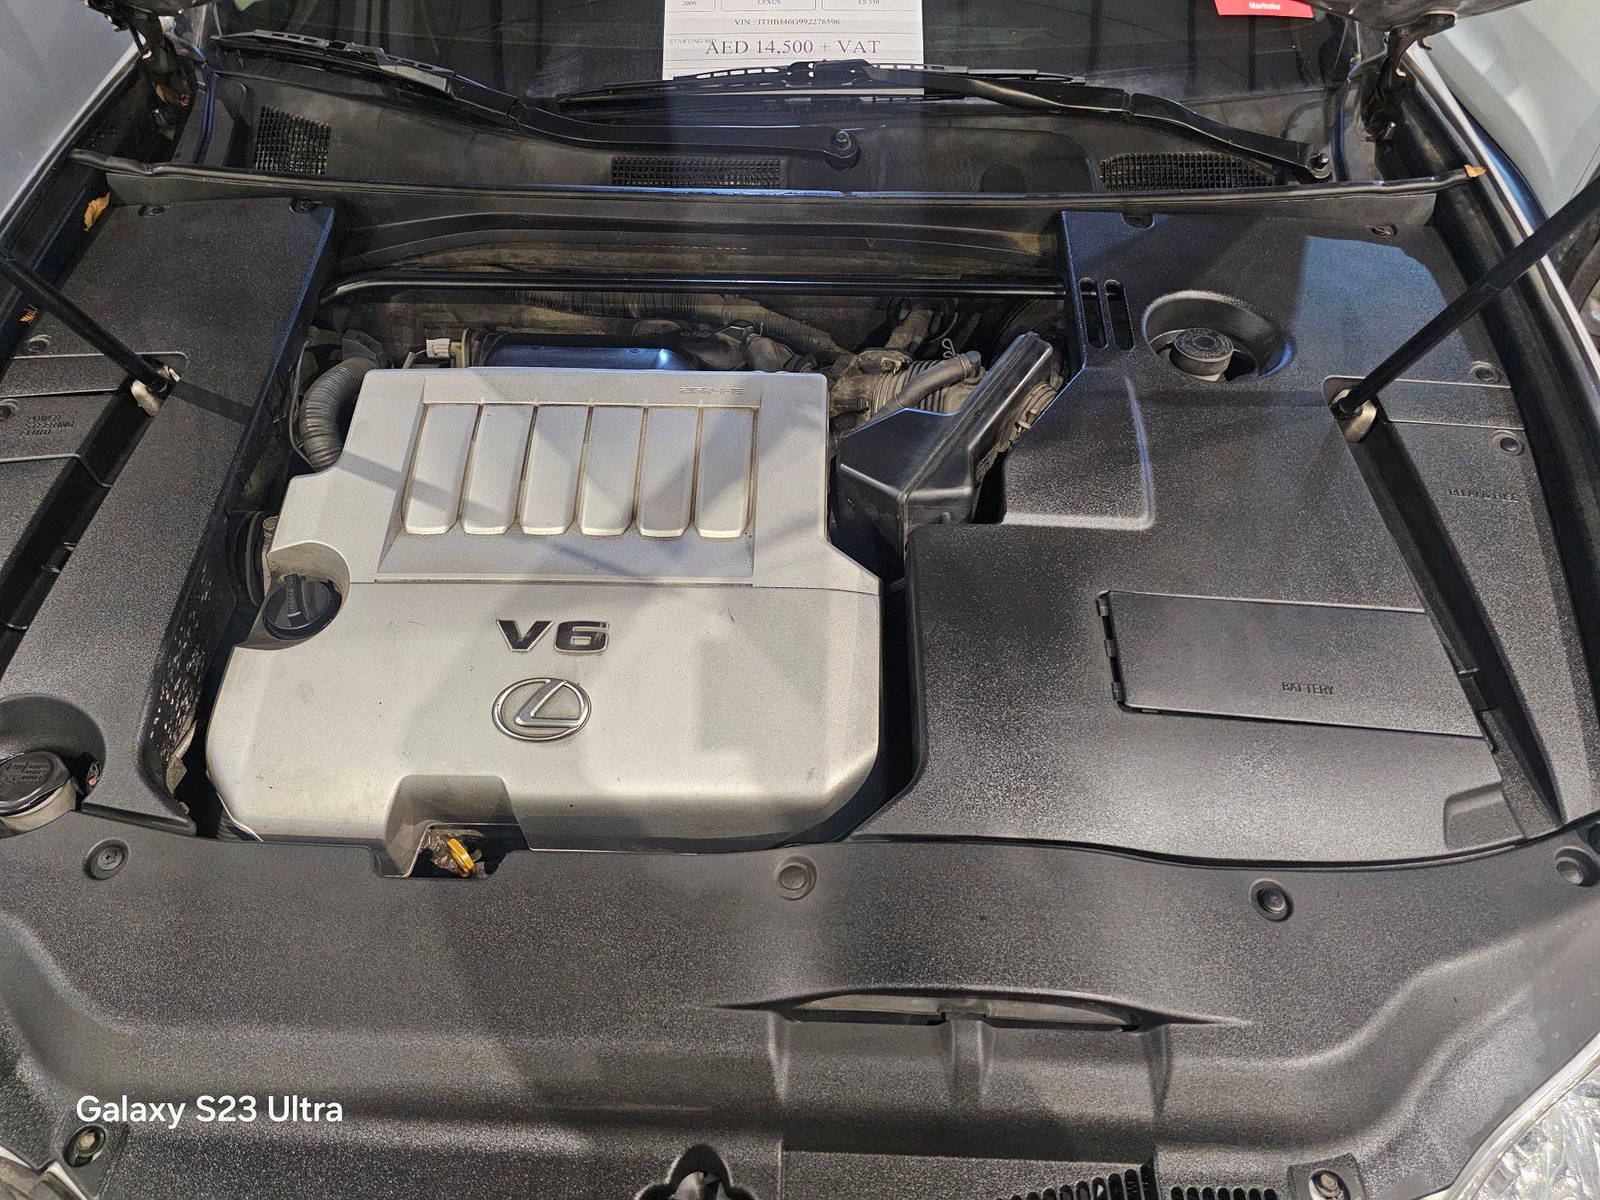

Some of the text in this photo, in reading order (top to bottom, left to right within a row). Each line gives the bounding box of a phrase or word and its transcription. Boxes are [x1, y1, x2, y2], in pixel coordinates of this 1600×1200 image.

[706, 39, 881, 55] AED 14,500 + VAT
[496, 619, 610, 653] V6
[1281, 681, 1335, 696] BATTERY
